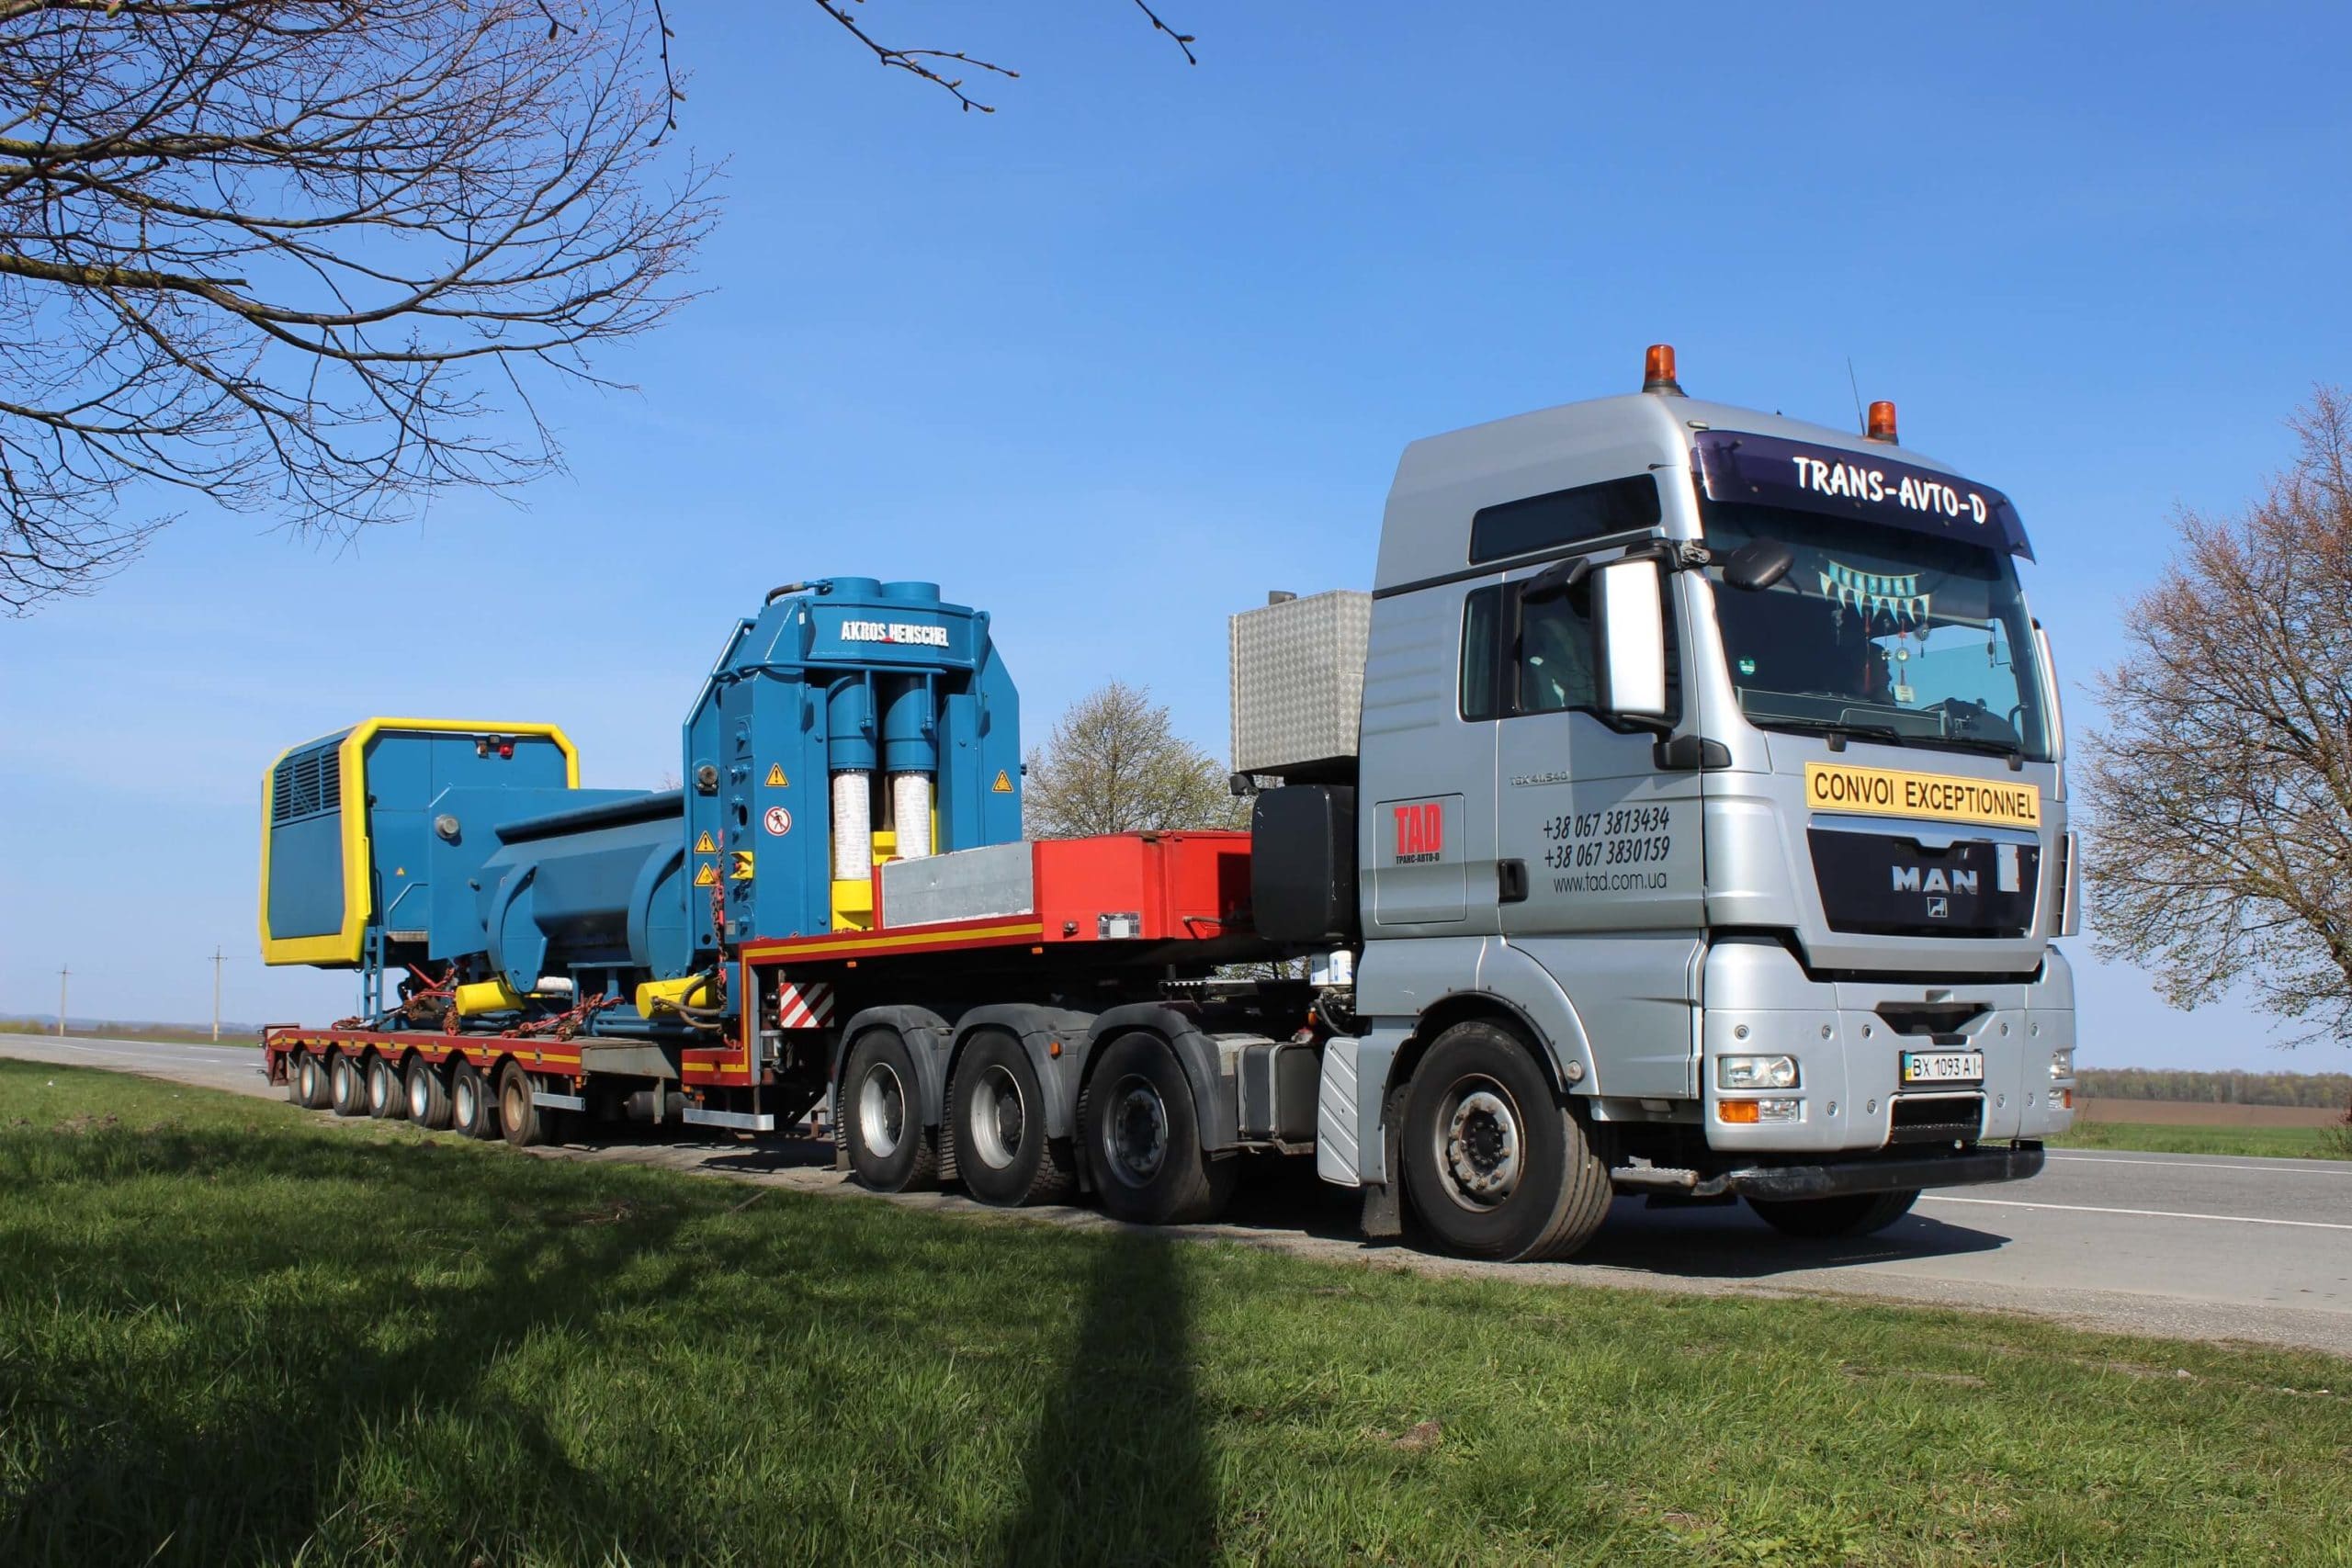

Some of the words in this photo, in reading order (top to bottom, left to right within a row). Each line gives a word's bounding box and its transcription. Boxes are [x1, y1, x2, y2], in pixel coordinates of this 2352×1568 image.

[1792, 457, 1986, 525] TRANS-AVTO-D
[841, 621, 886, 641] AKROS
[888, 624, 949, 647] HENSCHEL
[1815, 773, 1894, 806] CONVOI
[1905, 781, 2036, 819] EXCEPTIONNEL
[1543, 816, 1571, 840] +38
[1575, 813, 1601, 838] 067
[1604, 807, 1670, 835] 3813434
[1544, 845, 1573, 869] +38
[1577, 841, 1603, 867] 067
[1606, 836, 1670, 864] 3830159
[1554, 871, 1667, 894] www.tad.com.ua
[1892, 865, 1978, 895] MAN
[1913, 1058, 1930, 1077] BX
[1934, 1057, 1960, 1076] 1093
